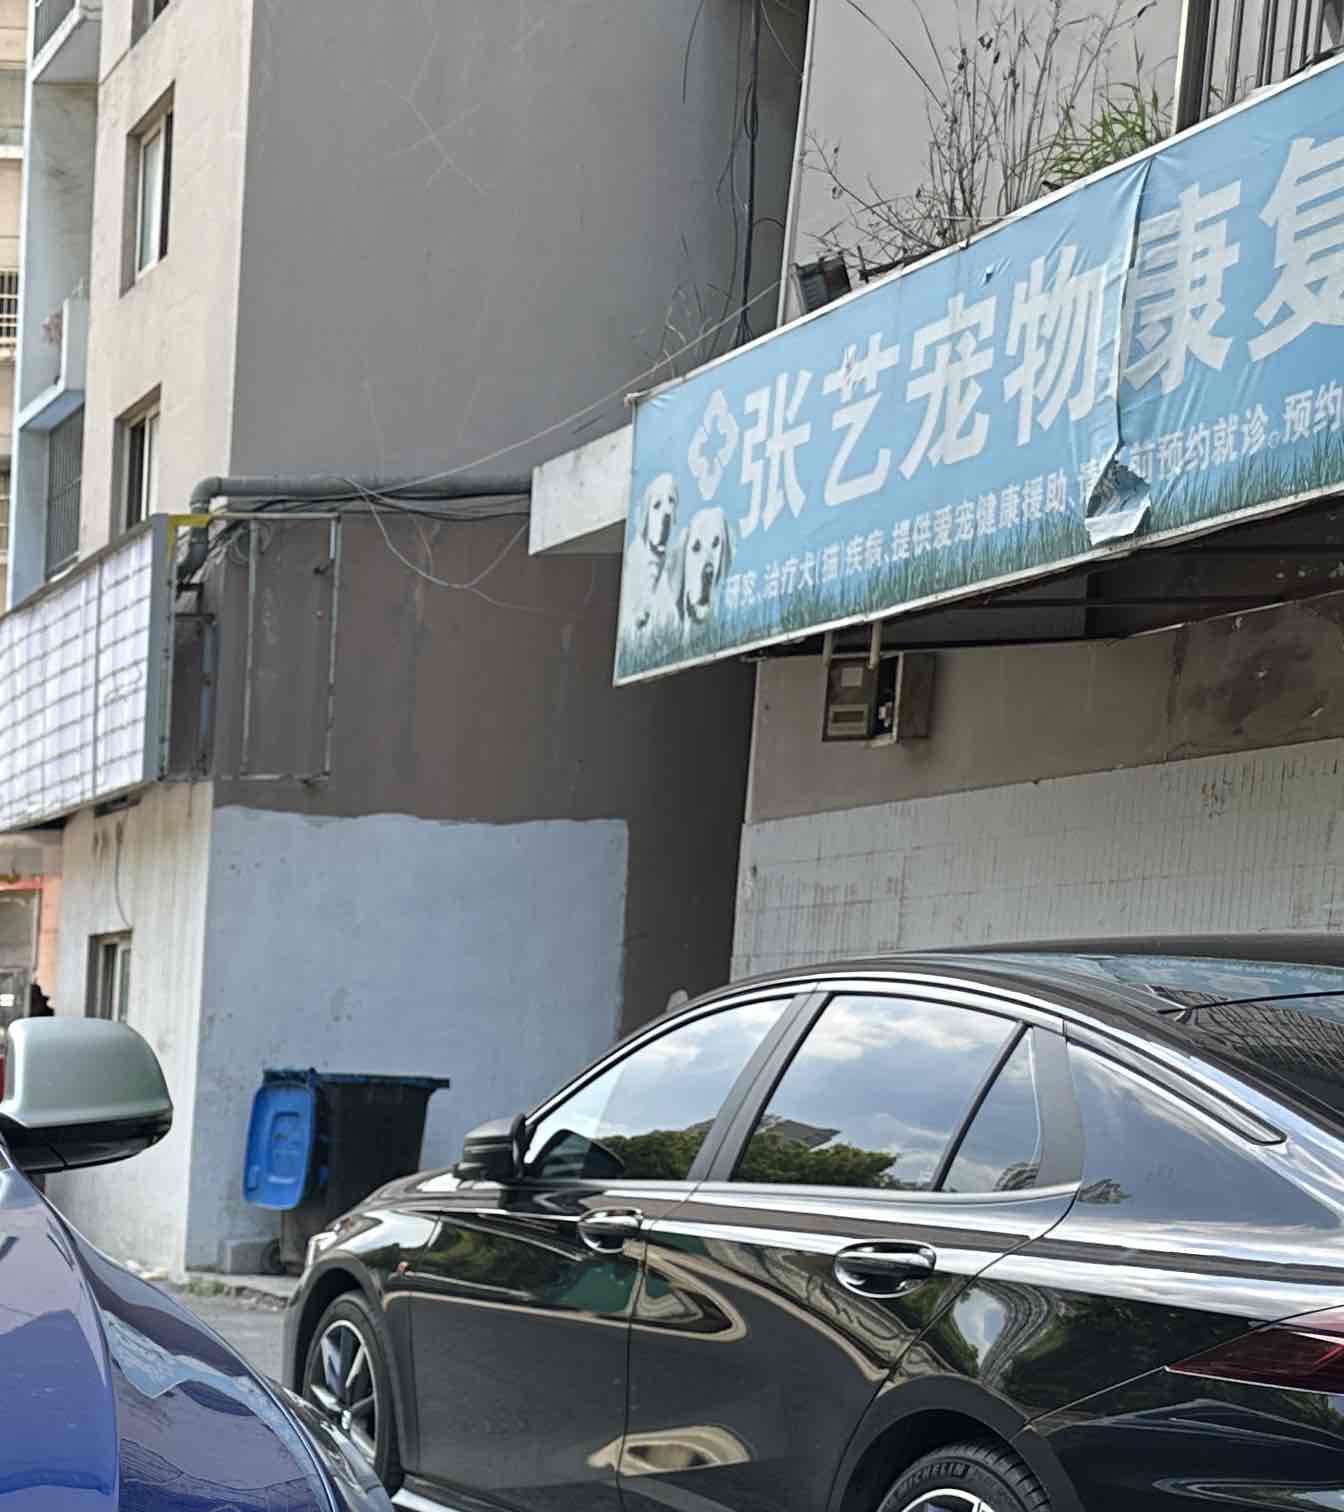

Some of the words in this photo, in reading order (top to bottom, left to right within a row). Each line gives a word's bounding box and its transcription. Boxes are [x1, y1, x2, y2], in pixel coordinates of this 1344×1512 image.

[738, 137, 1344, 538] 张艺宠物康复
